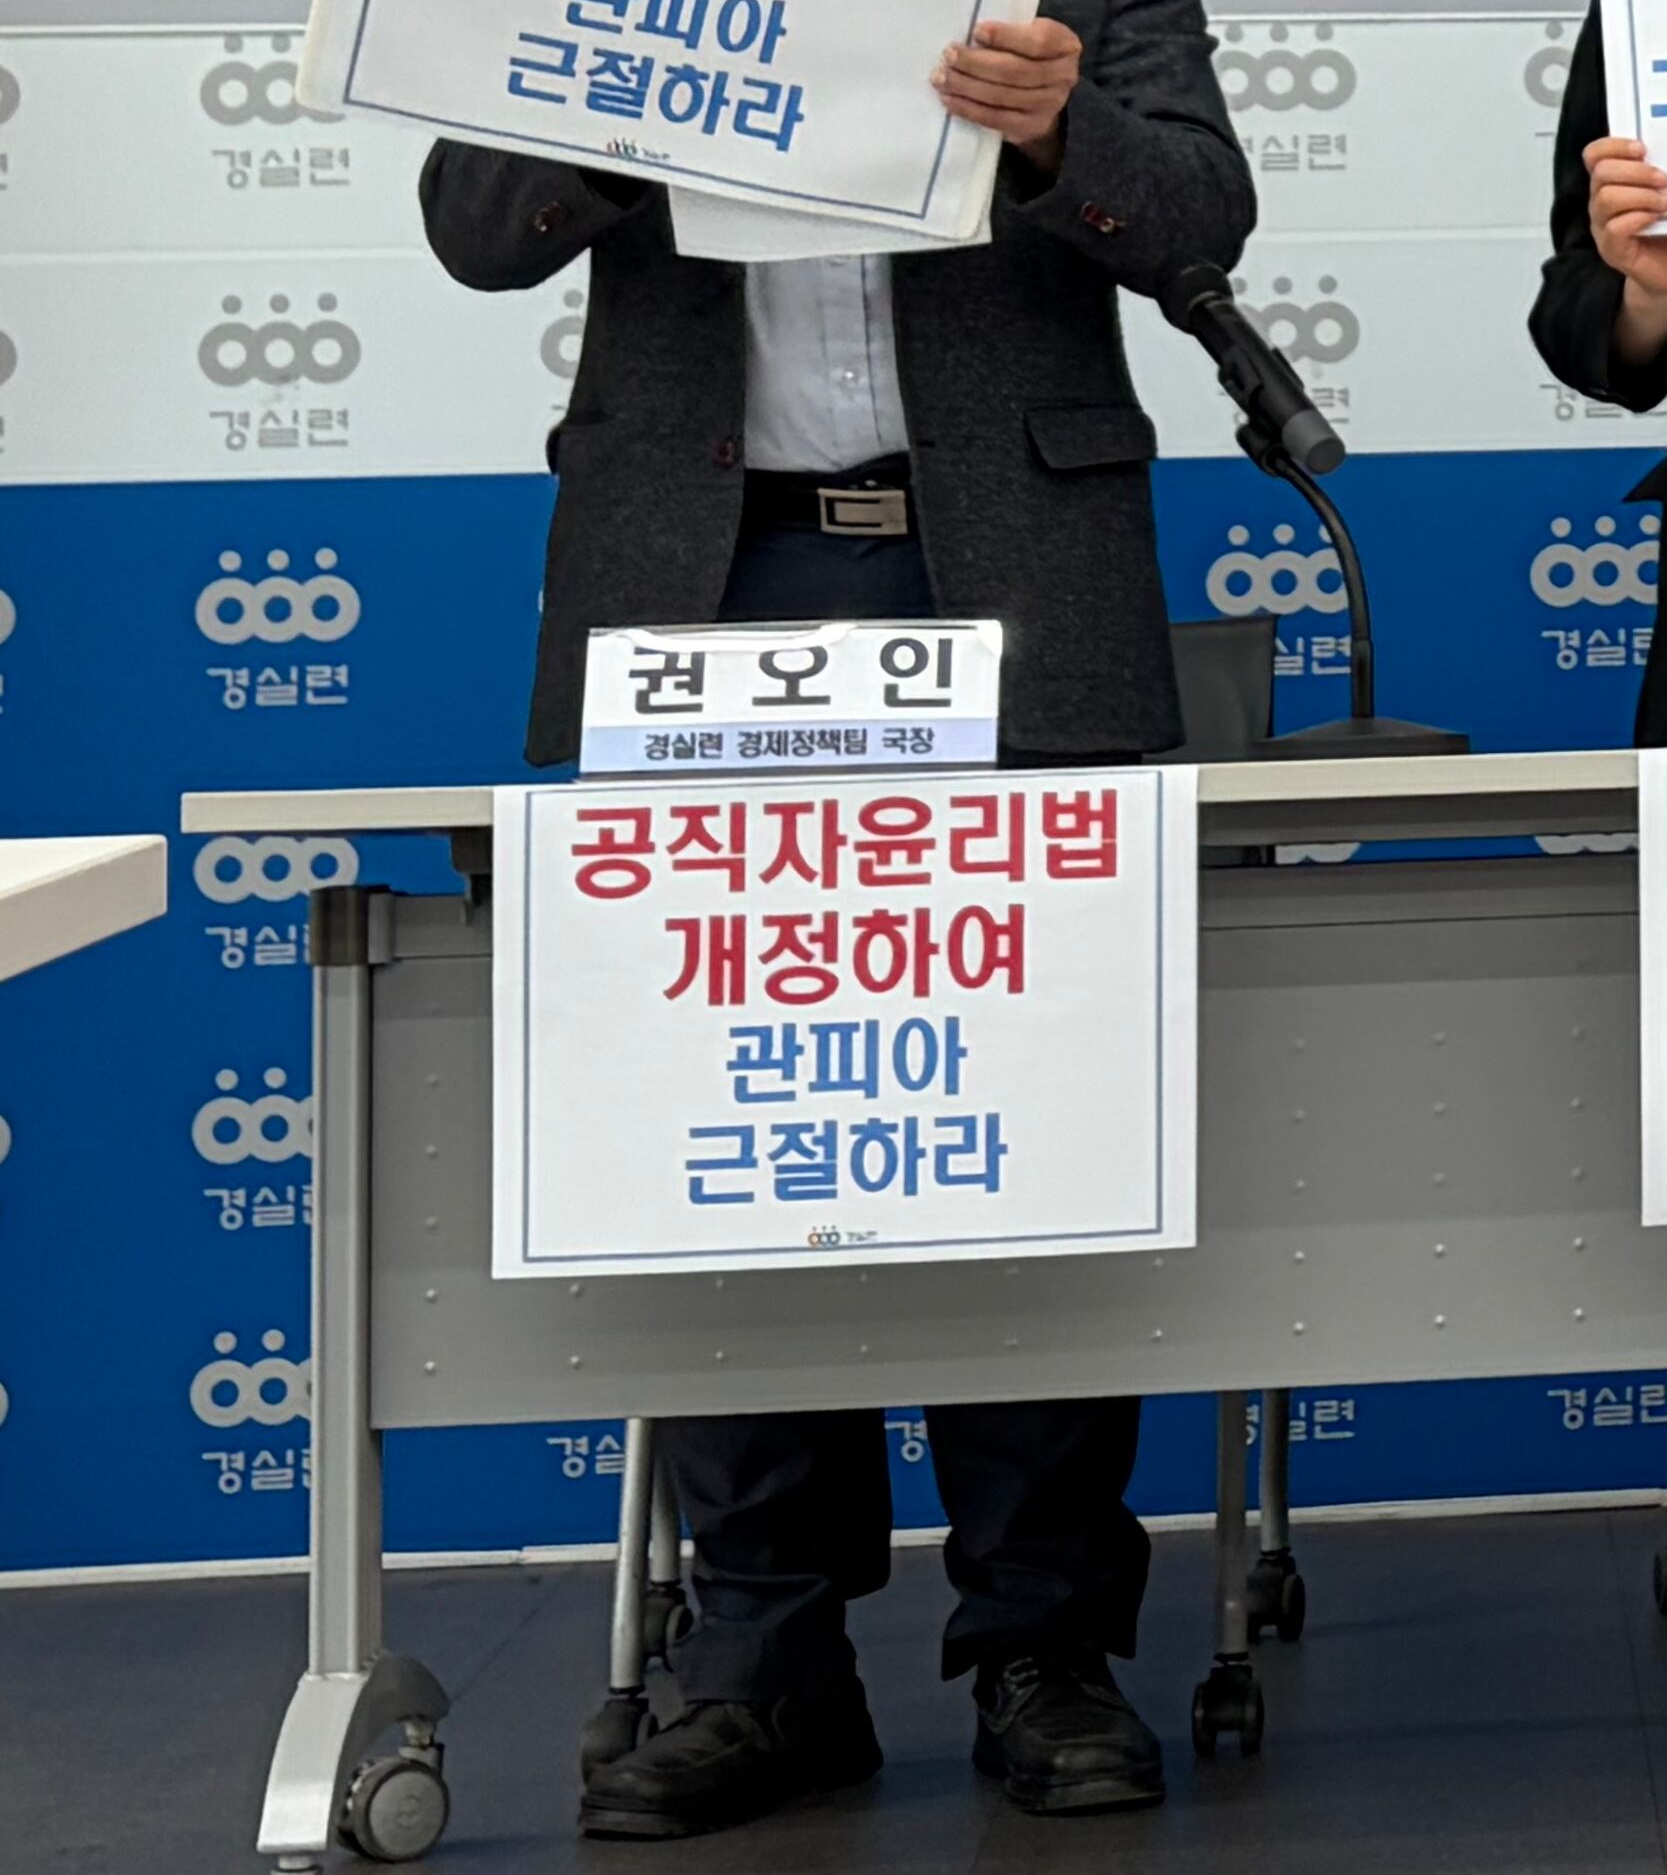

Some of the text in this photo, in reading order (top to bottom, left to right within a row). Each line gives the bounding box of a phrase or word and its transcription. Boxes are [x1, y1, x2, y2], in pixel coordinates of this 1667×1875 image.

[507, 31, 804, 152] 근절하라
[211, 145, 350, 189] 경실련
[1241, 133, 1347, 172] 실련
[209, 407, 348, 451] 경실련
[1272, 635, 1351, 676] 실련
[206, 664, 349, 710] 경실련
[645, 725, 936, 761] 경실련 경제정책팀 국장
[571, 788, 1118, 900] 공직자윤리법
[204, 924, 310, 969] 경실
[662, 903, 1026, 1007] 개정하여
[726, 1015, 968, 1104] 관피아
[684, 1111, 1009, 1205] 근절하라
[204, 1185, 312, 1230] 경실
[202, 1450, 311, 1495] 경실
